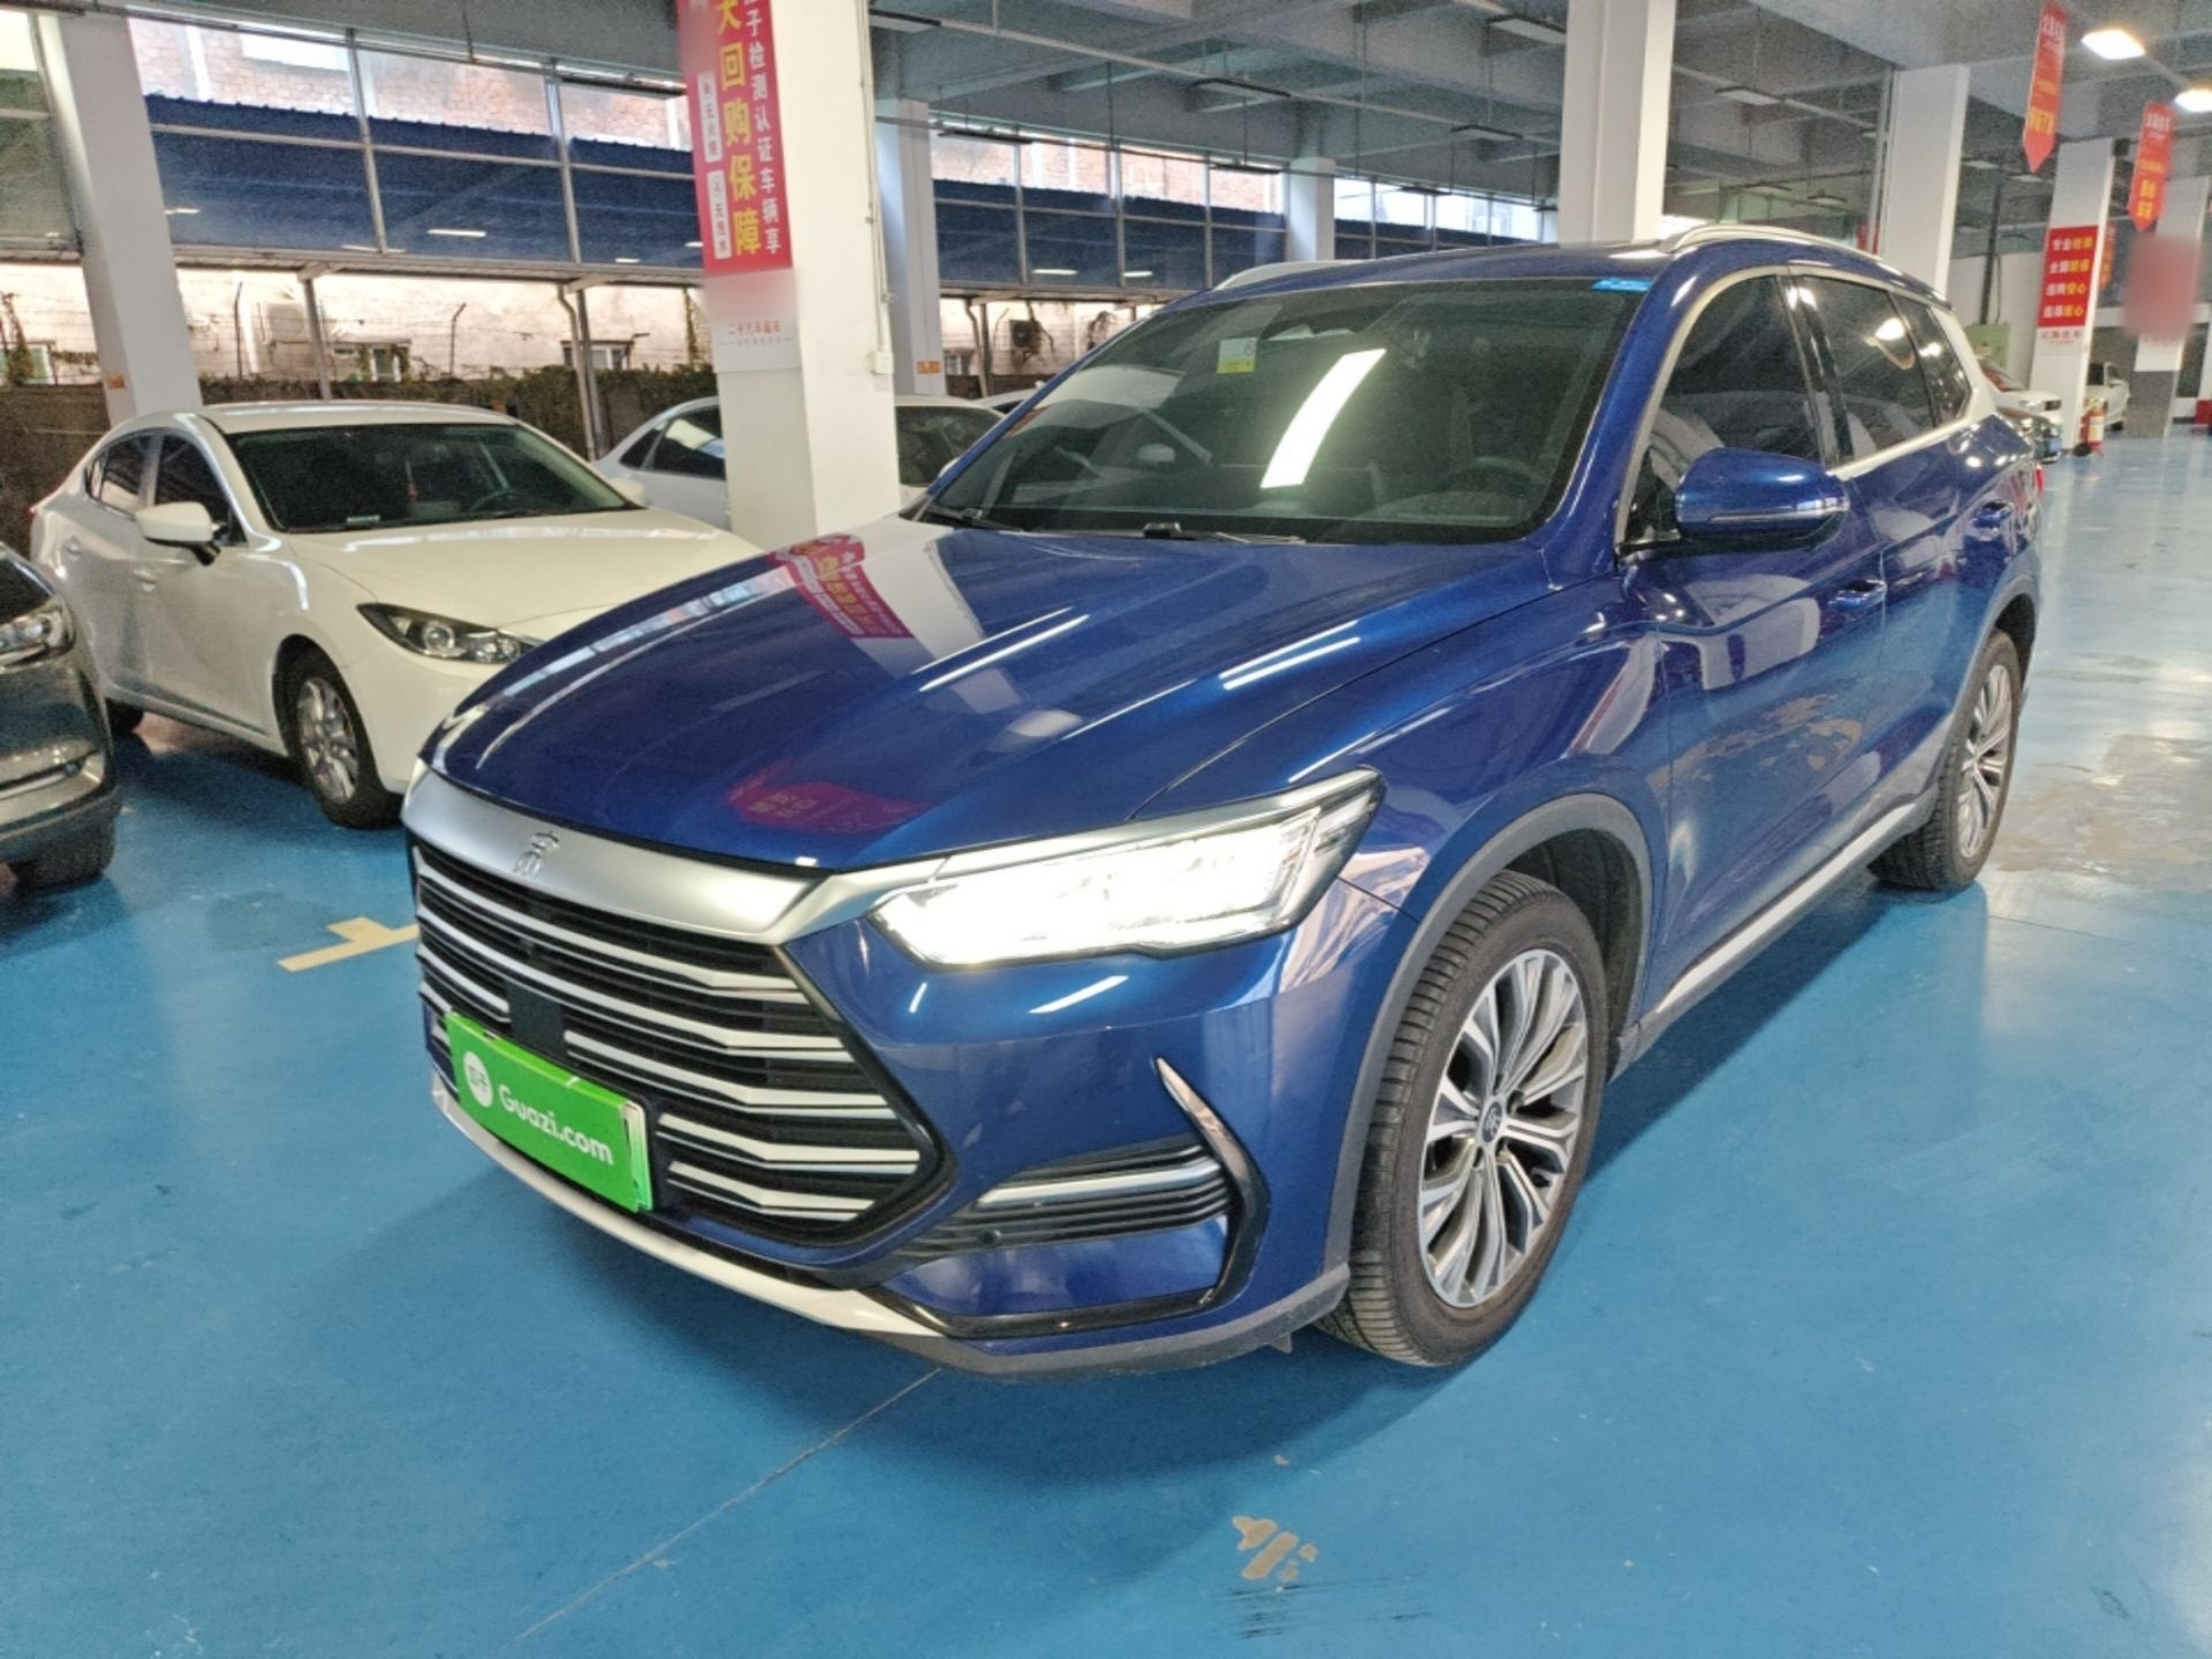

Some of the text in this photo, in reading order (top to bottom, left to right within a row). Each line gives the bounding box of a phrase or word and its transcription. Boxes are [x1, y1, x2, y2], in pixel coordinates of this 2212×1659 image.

[744, 0, 781, 254] 子检测认证车辆享
[498, 1084, 614, 1166] Guazi.com
